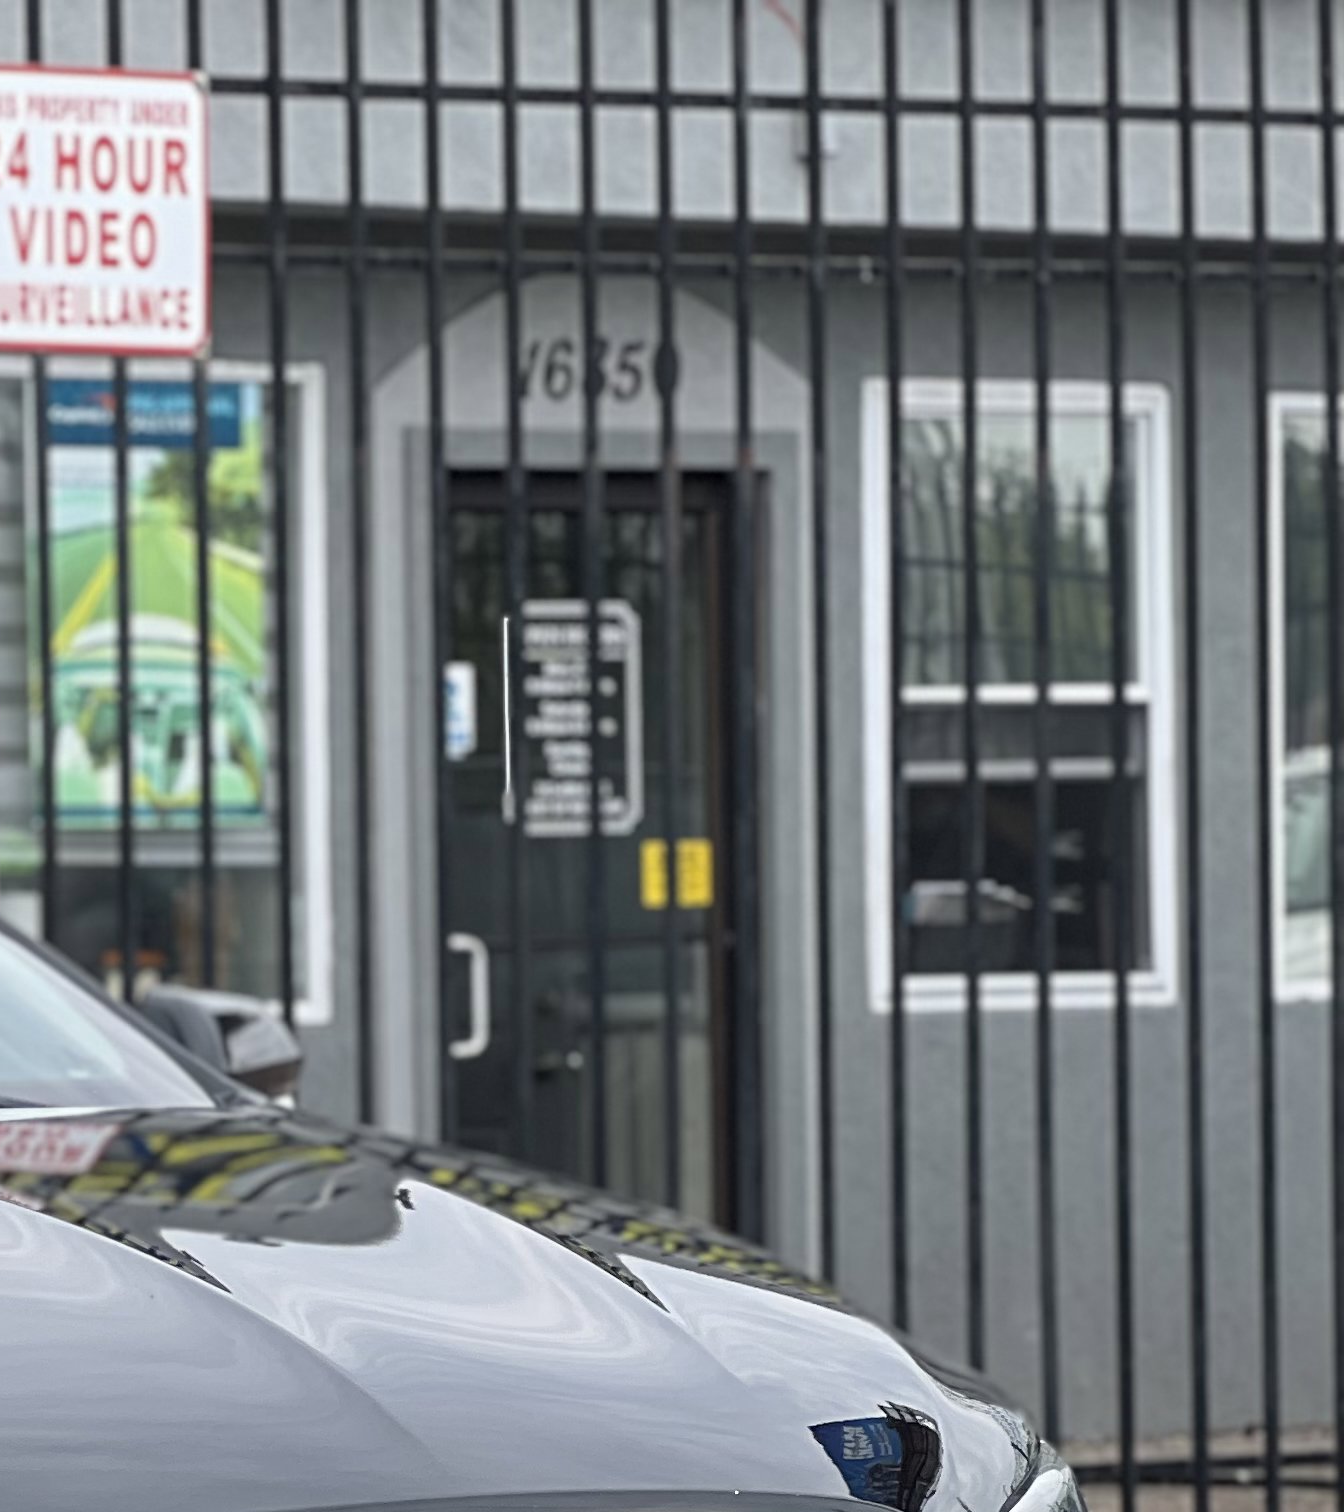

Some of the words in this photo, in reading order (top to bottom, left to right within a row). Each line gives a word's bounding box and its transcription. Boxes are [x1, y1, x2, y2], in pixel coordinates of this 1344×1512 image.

[27, 95, 120, 124] PROPERTY
[131, 101, 188, 128] UNDER
[55, 133, 188, 195] HOUR
[10, 207, 156, 269] VIDEO
